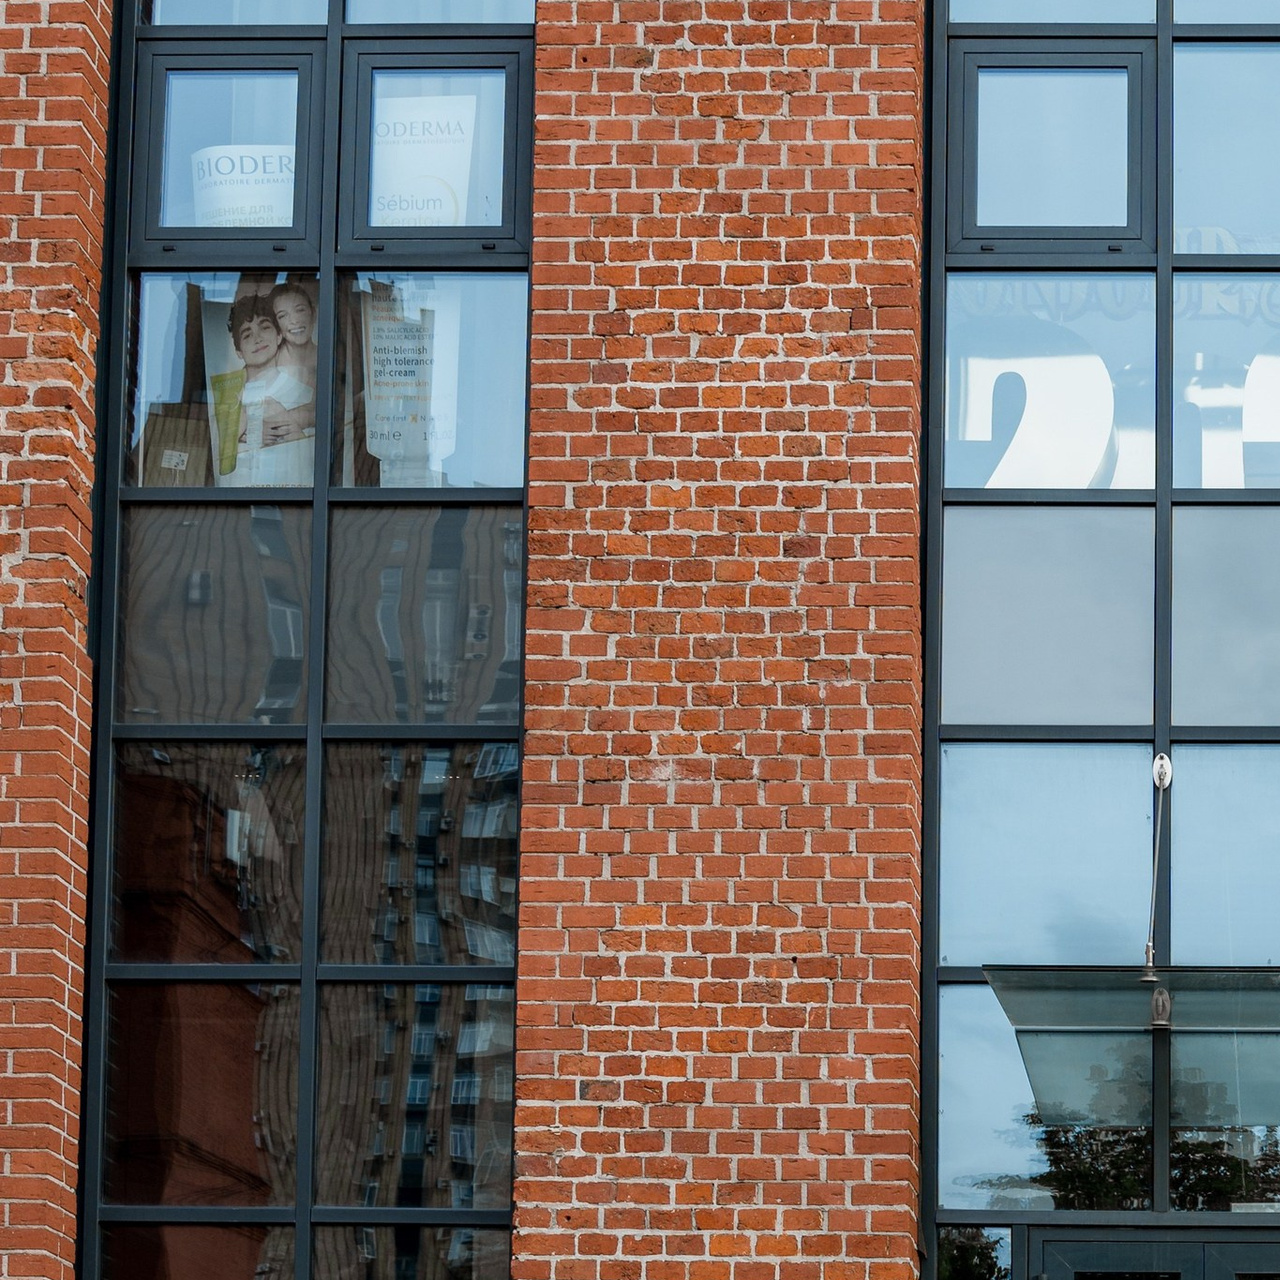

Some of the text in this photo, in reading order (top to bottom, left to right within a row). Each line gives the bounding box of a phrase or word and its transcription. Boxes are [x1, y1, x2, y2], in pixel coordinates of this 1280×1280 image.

[375, 121, 465, 138] ODERMA
[377, 194, 443, 212] Sébium
[248, 204, 274, 216] ДЛЯ
[373, 346, 428, 355] Anti-blemish
[374, 357, 435, 368] high tolerance
[374, 369, 416, 379] gel-cream
